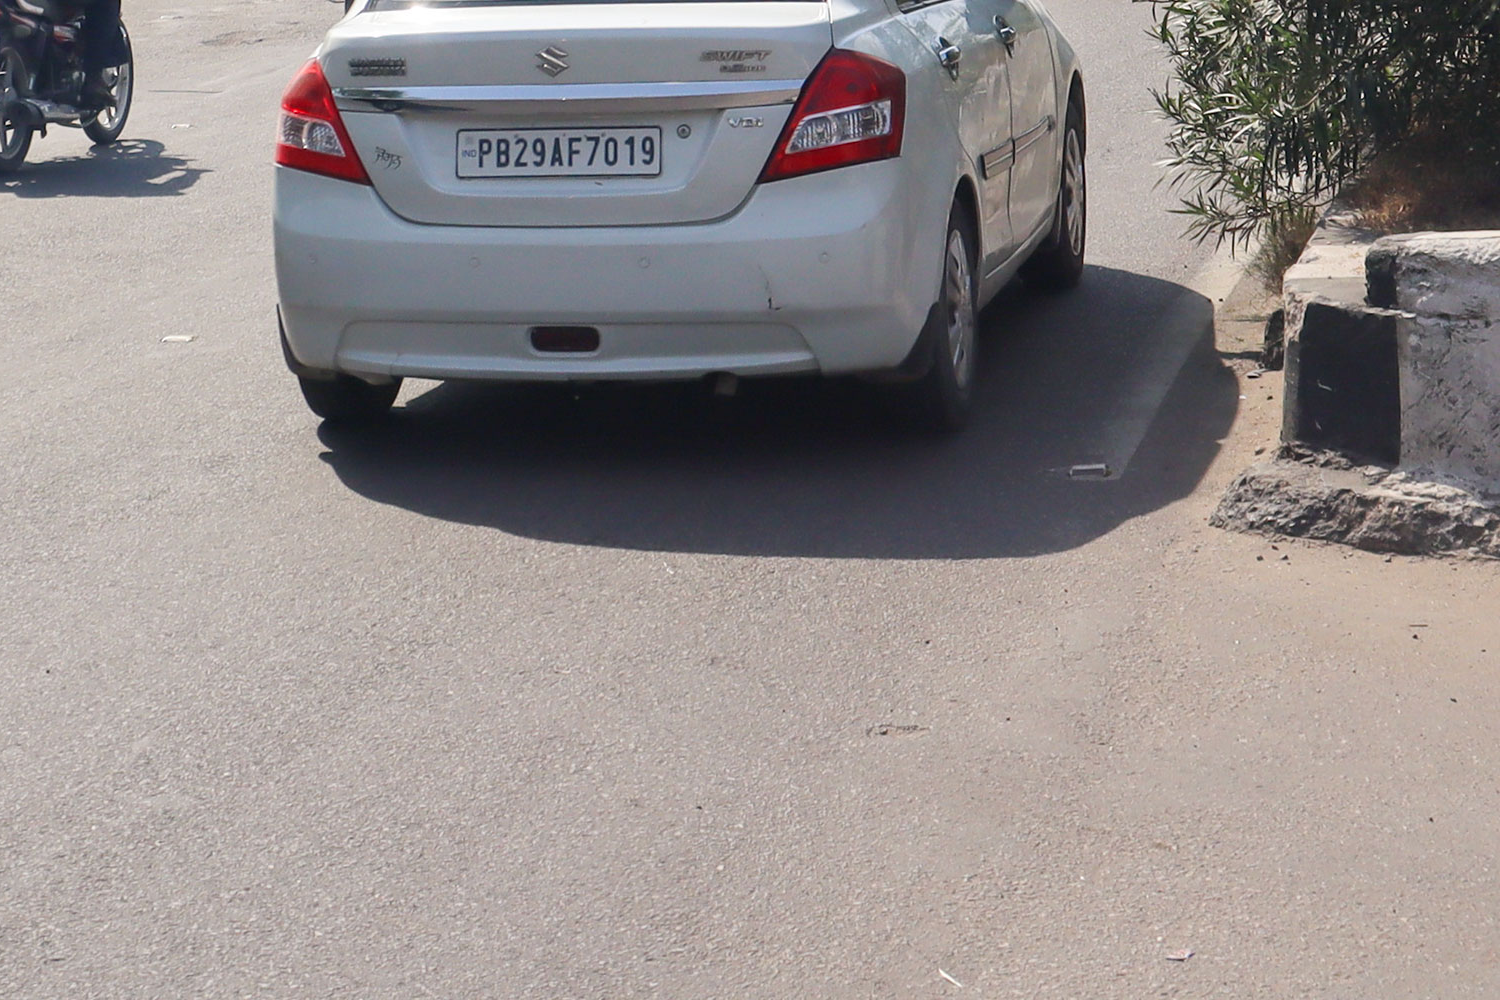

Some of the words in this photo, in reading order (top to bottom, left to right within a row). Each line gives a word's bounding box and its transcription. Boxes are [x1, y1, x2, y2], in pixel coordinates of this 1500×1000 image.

[699, 49, 772, 61] SWIFT
[461, 149, 477, 158] IND
[478, 134, 656, 168] PB29AF7019
